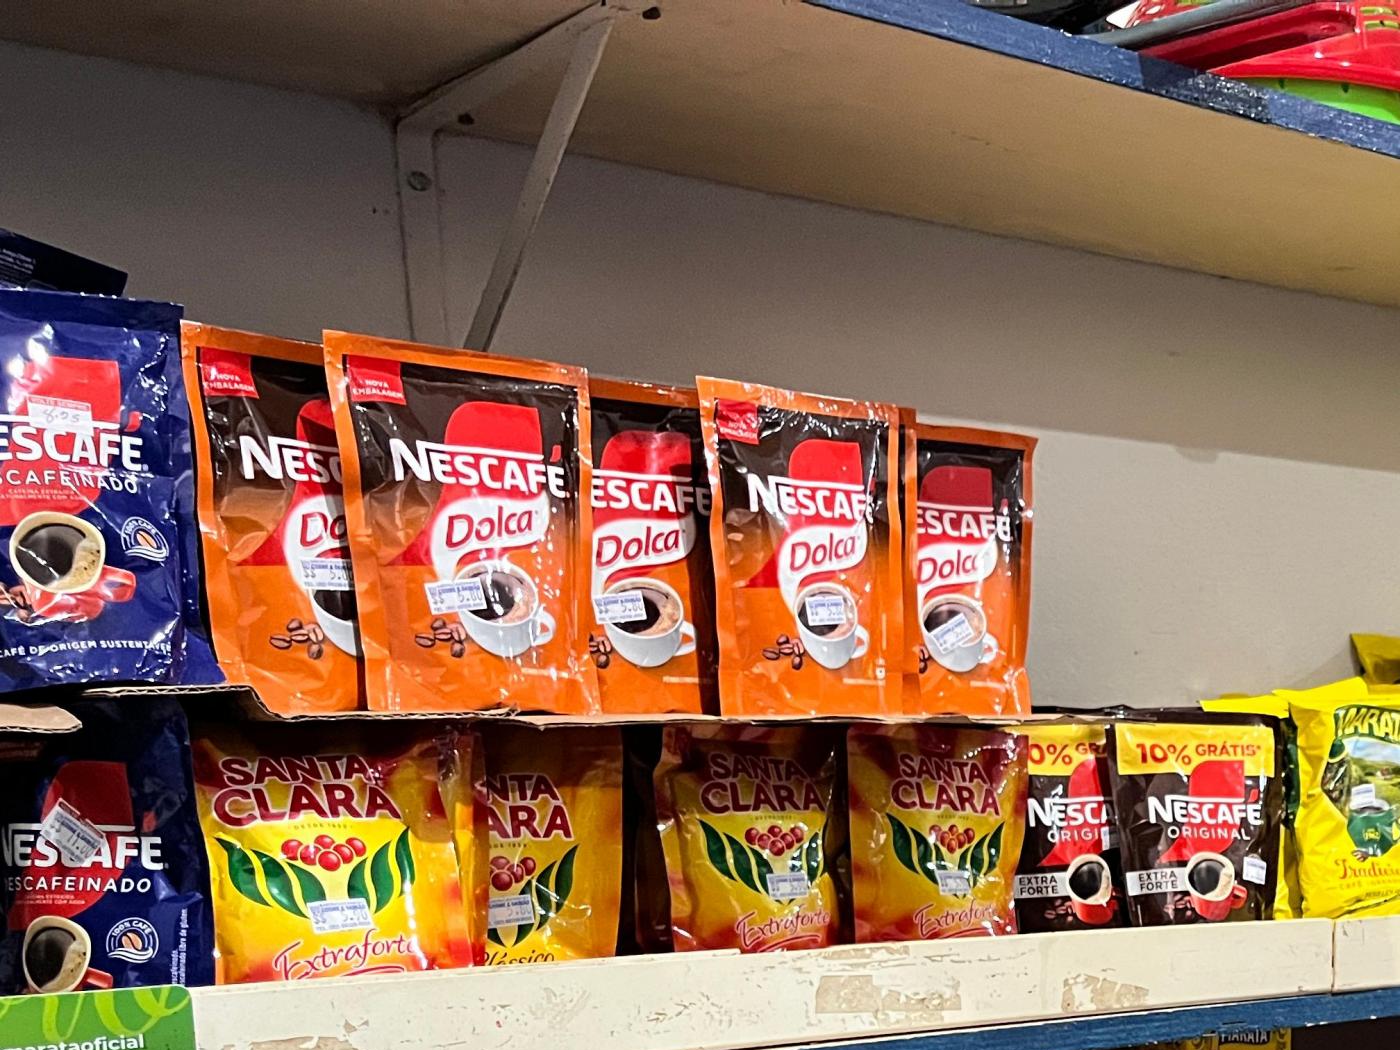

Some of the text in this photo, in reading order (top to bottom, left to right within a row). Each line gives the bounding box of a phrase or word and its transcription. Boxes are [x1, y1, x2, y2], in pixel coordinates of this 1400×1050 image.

[0, 411, 144, 472] ESCAFÉ
[0, 468, 138, 494] CAFEINADO
[446, 505, 533, 549] Dolca
[596, 525, 680, 568] Dolca
[789, 532, 857, 573] Dolca
[50, 639, 98, 653] ORIGEM
[219, 754, 378, 787] SANTA
[708, 751, 812, 784] SANTA
[900, 753, 991, 787] SANTA
[1136, 743, 1192, 767] 10%
[213, 781, 403, 829] CLARA
[700, 778, 829, 817] CLARA
[890, 778, 1002, 818] CLARA
[1048, 827, 1107, 844] ORIGI
[1168, 825, 1251, 841] ORIGINAL
[6, 876, 152, 893] ESCAFEINADO
[1019, 876, 1058, 886] EXTRA
[1020, 885, 1059, 896] FORTE
[1138, 871, 1178, 882] EXTRA
[1140, 881, 1179, 892] FORTE
[736, 904, 831, 948] Extraforte
